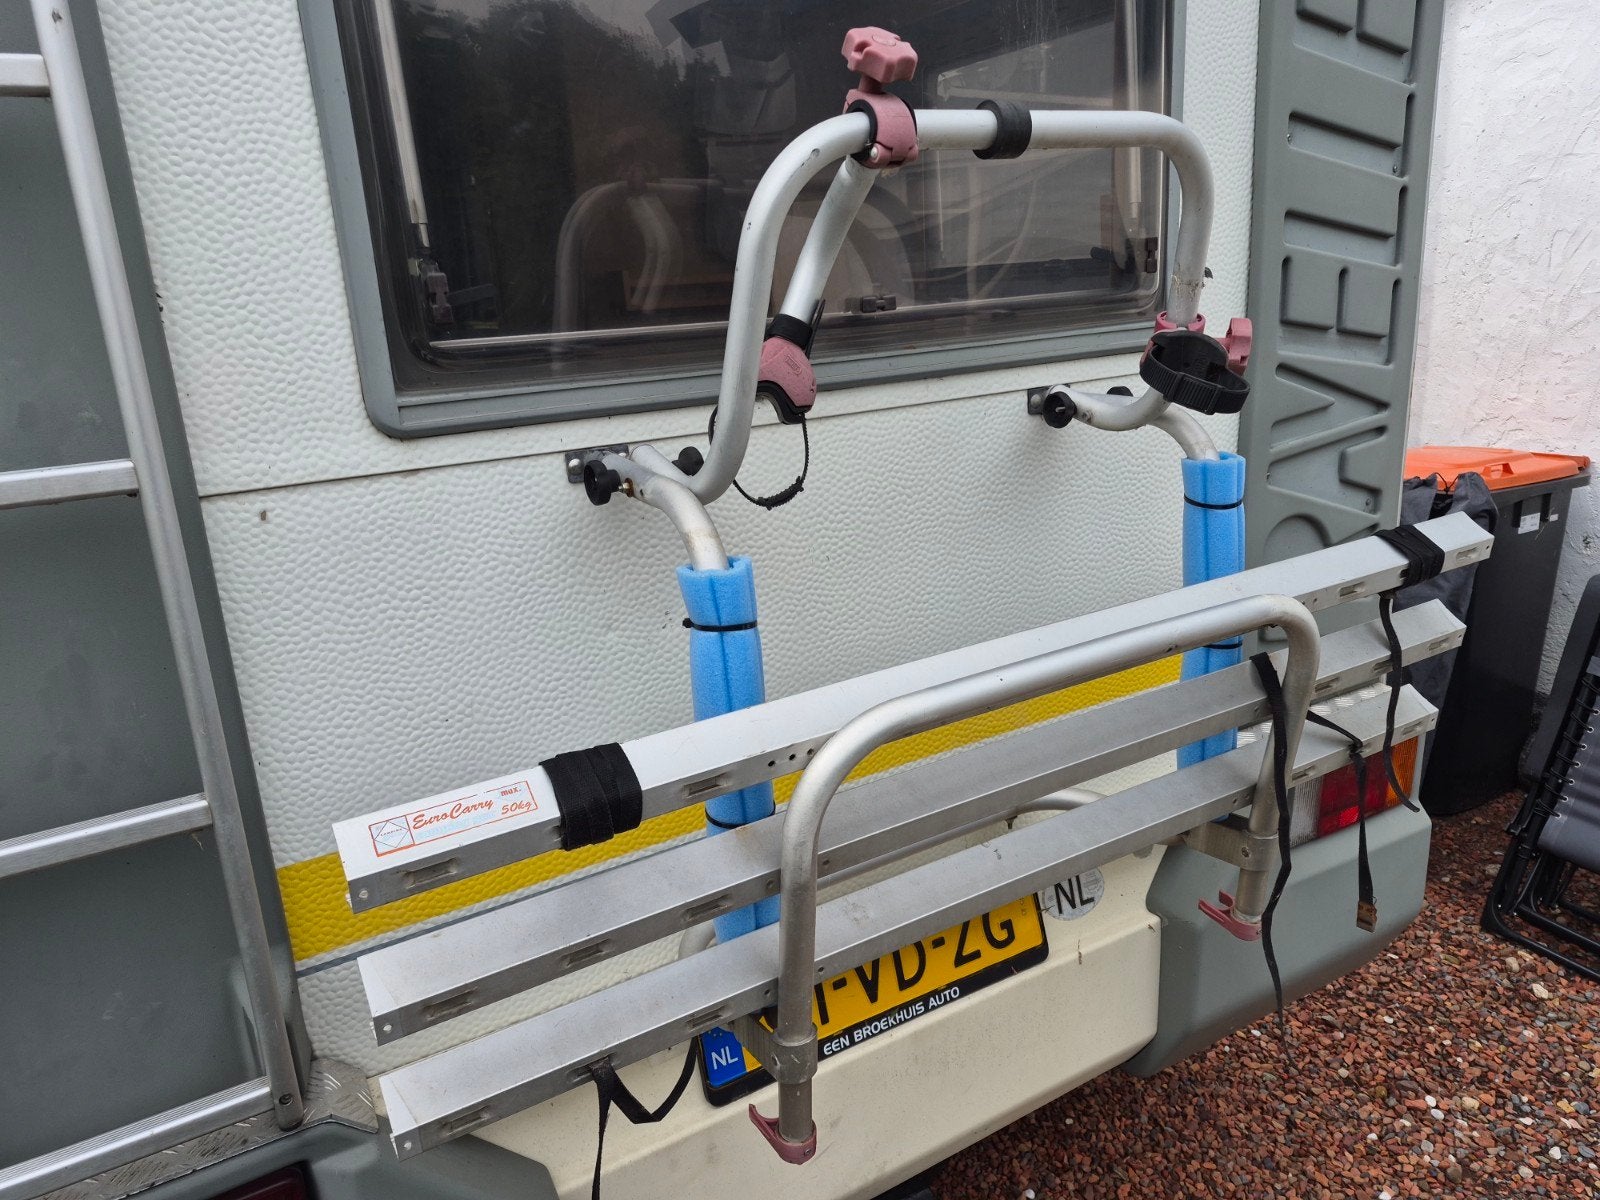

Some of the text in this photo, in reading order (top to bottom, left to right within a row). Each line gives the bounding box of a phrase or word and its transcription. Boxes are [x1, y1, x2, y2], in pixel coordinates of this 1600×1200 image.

[412, 799, 494, 830] EuroCarry
[501, 800, 532, 815] 50kg
[1054, 874, 1095, 914] NL
[823, 986, 960, 1055] EEN BROEKHUIS AUTO
[711, 1045, 739, 1070] NL
